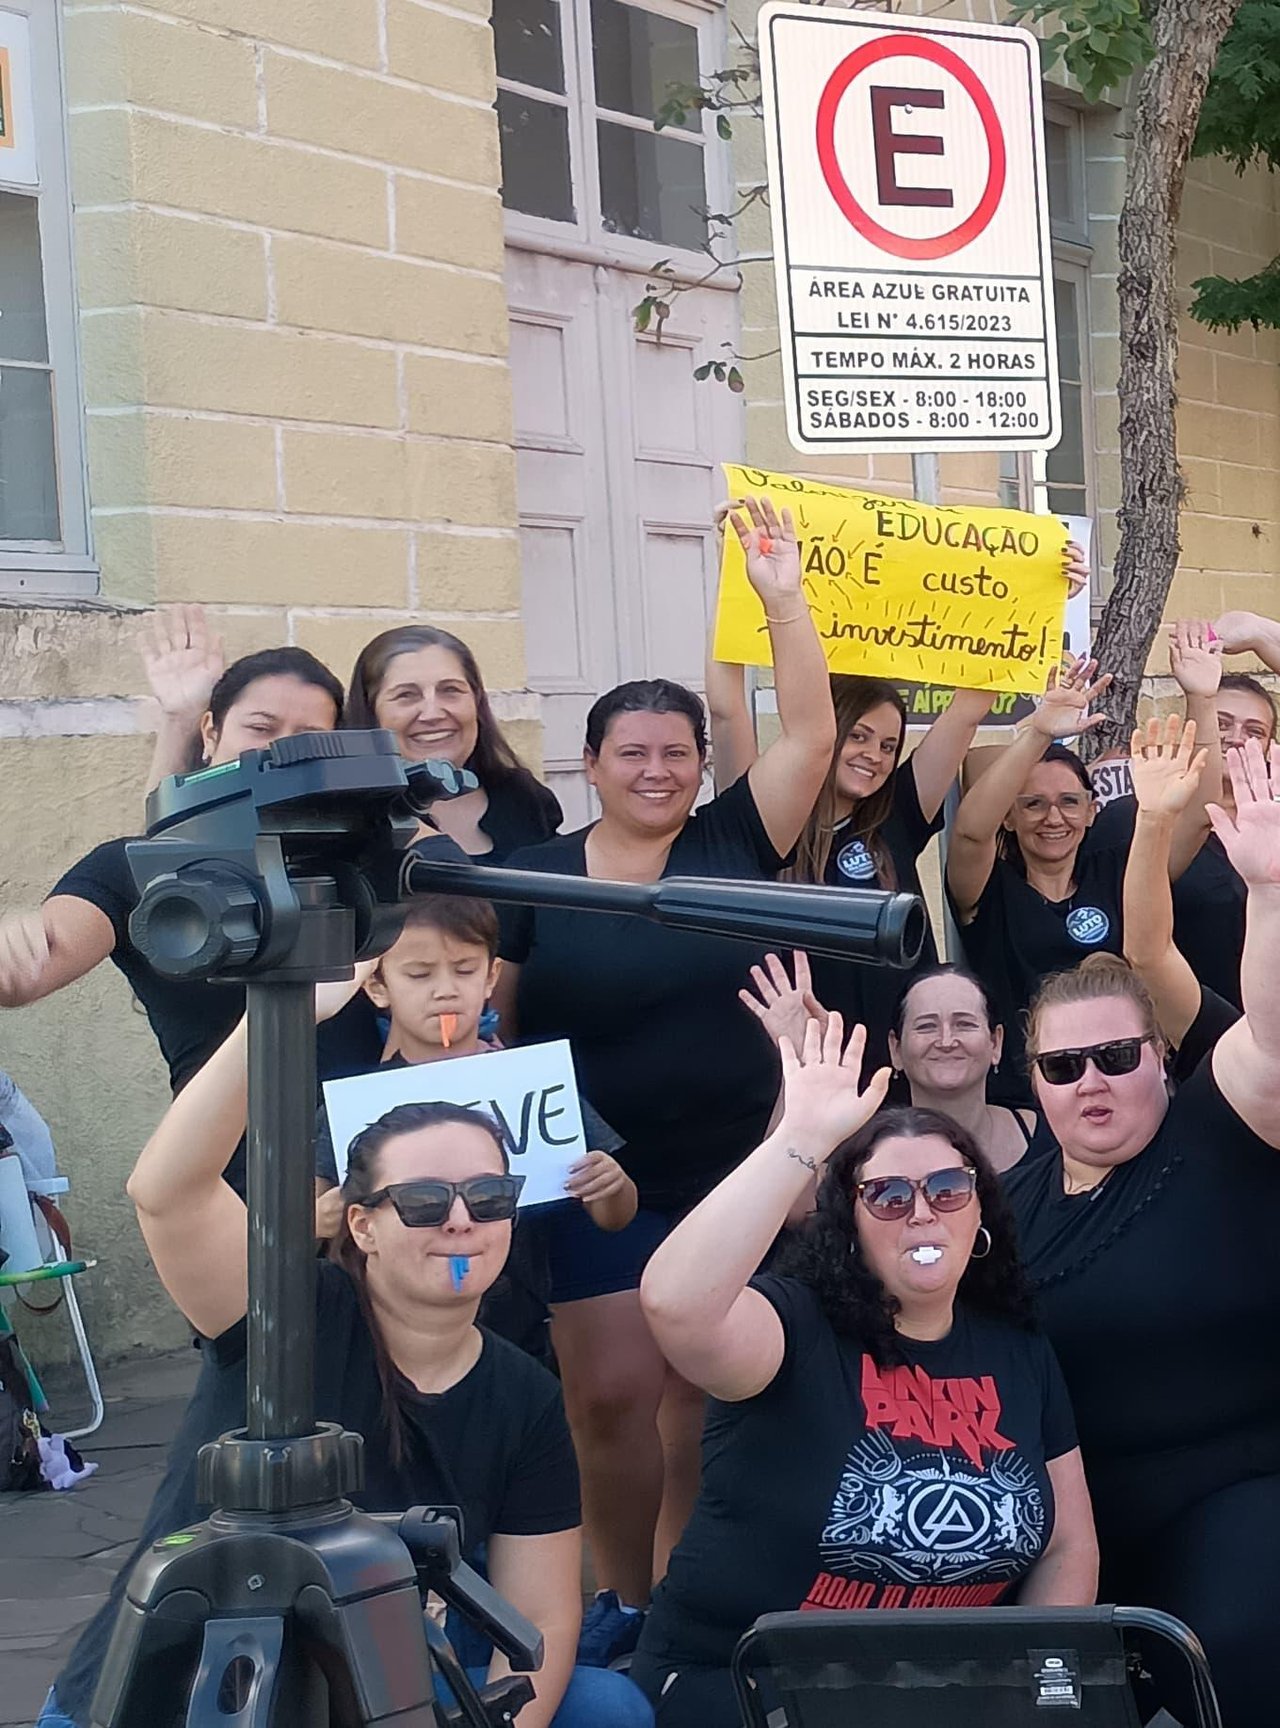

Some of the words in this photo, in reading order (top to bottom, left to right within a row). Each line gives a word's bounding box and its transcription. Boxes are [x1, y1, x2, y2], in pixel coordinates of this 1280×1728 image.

[870, 85, 954, 208] E
[809, 276, 865, 299] ÁREA
[872, 282, 925, 300] AZUL
[932, 284, 1030, 303] GRATUITA
[838, 312, 869, 328] LEI
[906, 314, 1012, 332] 4.615/2023
[811, 351, 885, 369] TEMPO
[893, 347, 943, 370] MÁX.
[949, 352, 961, 369] 2
[968, 353, 1036, 370] HORAS
[807, 390, 896, 408] SEG/SEX
[916, 391, 957, 408] 8:00
[975, 391, 1027, 408] 18:00
[810, 407, 910, 428] SÁBADOS
[929, 412, 969, 429] 8:00
[988, 412, 1039, 428] 12:00
[876, 510, 1039, 557] EDUCAÇÃO
[797, 536, 847, 577] ÃO
[863, 542, 884, 585] É
[820, 611, 1048, 665] investimento!
